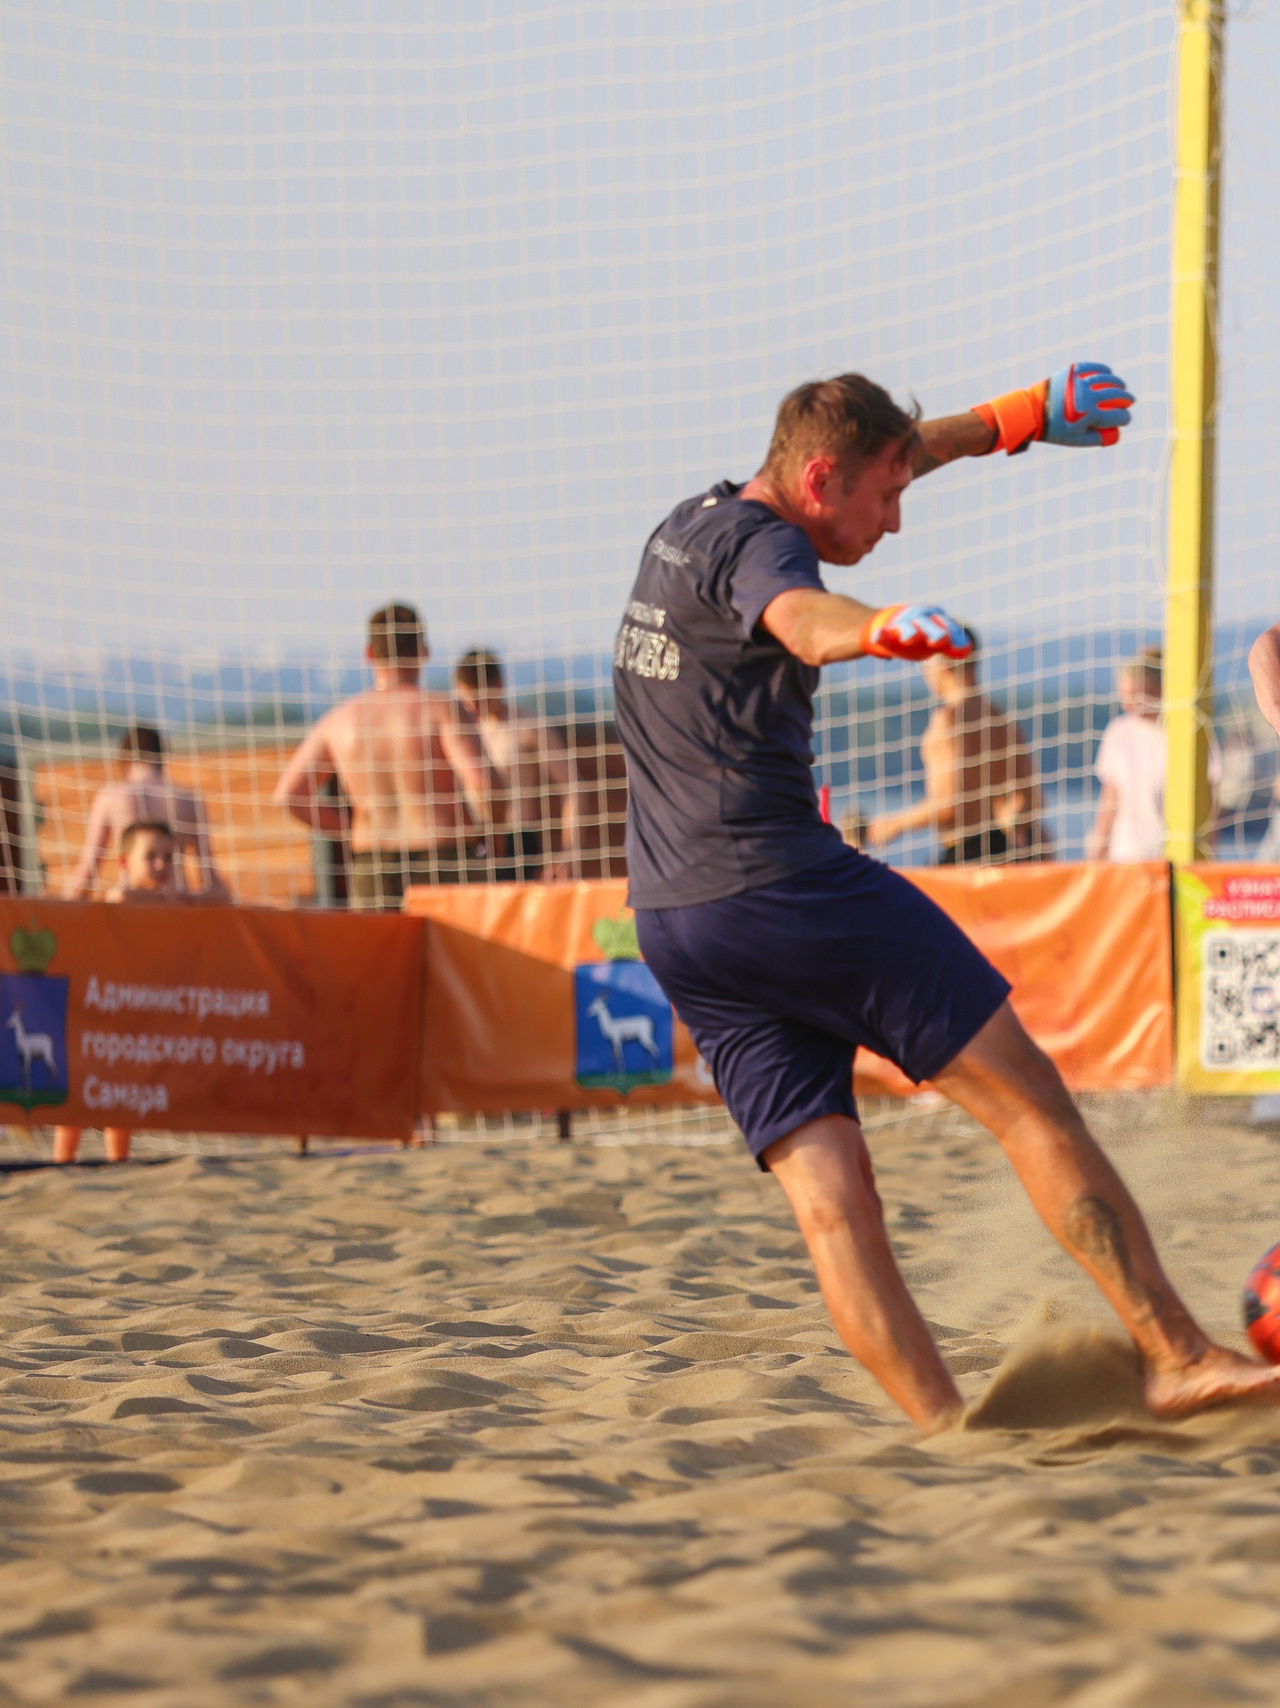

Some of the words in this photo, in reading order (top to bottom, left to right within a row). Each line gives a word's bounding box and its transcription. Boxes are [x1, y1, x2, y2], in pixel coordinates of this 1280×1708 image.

[84, 974, 271, 1022] Администрация
[81, 1030, 217, 1067] городского
[221, 1036, 305, 1075] округа
[83, 1073, 169, 1119] Самара
